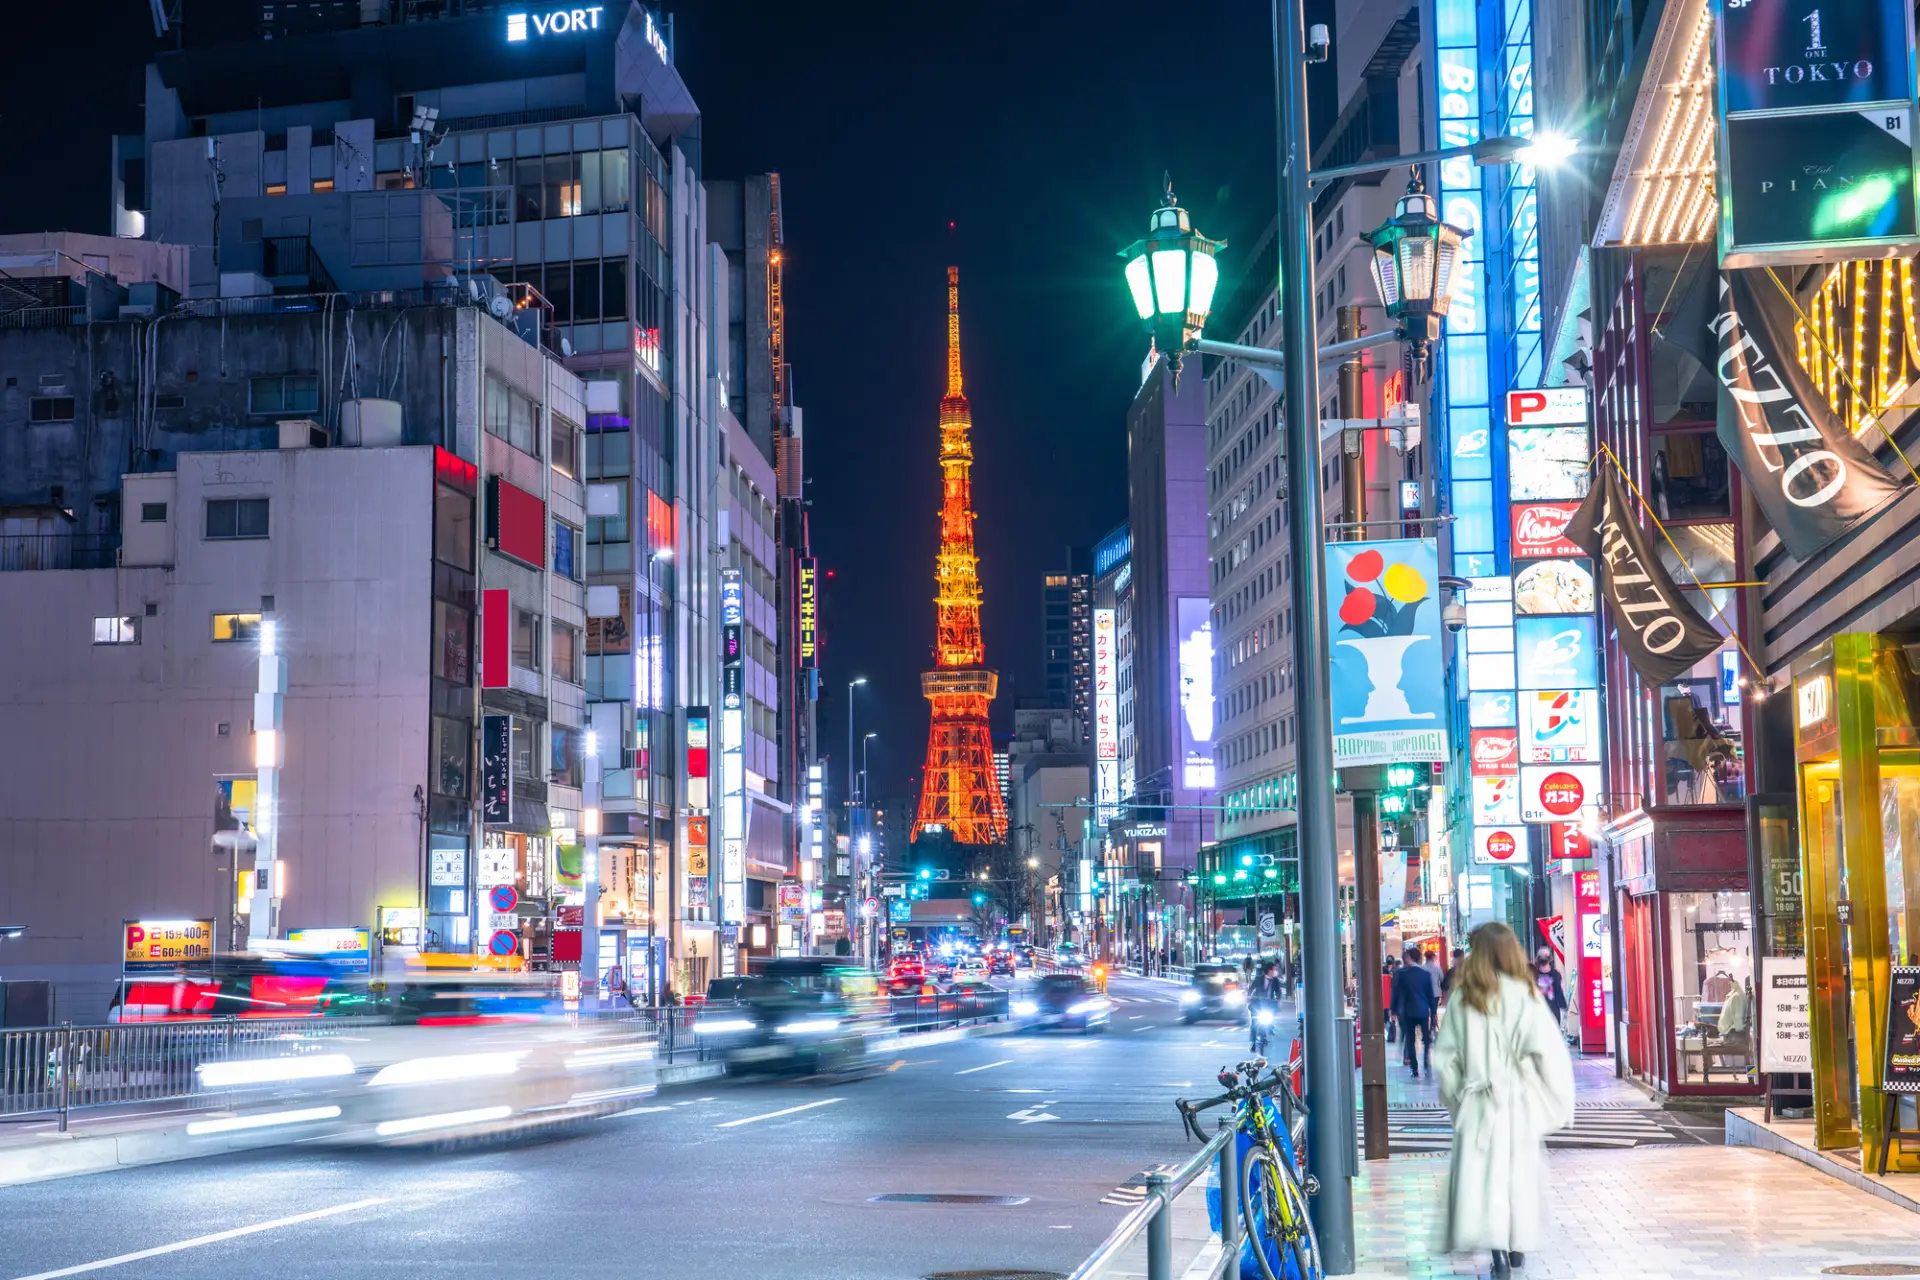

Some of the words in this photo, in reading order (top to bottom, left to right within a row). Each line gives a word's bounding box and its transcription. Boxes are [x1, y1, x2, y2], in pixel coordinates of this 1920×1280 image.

[532, 7, 603, 35] VORT
[1805, 50, 1828, 58] ONE
[1763, 60, 1874, 85] TOKYO
[1886, 116, 1902, 130] B1
[1802, 164, 1834, 176] Club
[1511, 392, 1547, 423] P
[1521, 547, 1553, 555] STEAK
[1097, 634, 1109, 691] カラオケ
[1545, 790, 1580, 804] ガスト
[1525, 810, 1544, 818] B1F
[1124, 828, 1167, 837] YUKIZAKI
[1489, 842, 1514, 853] ガスト
[1581, 872, 1598, 881] Café
[1775, 902, 1795, 911] 18:00
[183, 926, 209, 939] 400円
[127, 926, 145, 951] P
[126, 950, 145, 958] ORIX
[162, 947, 182, 957] 60分
[182, 944, 209, 957] 400円
[1776, 978, 1808, 986] 本日の営業
[1776, 1021, 1784, 1029] 2F
[1783, 1055, 1807, 1063] MEZZO
